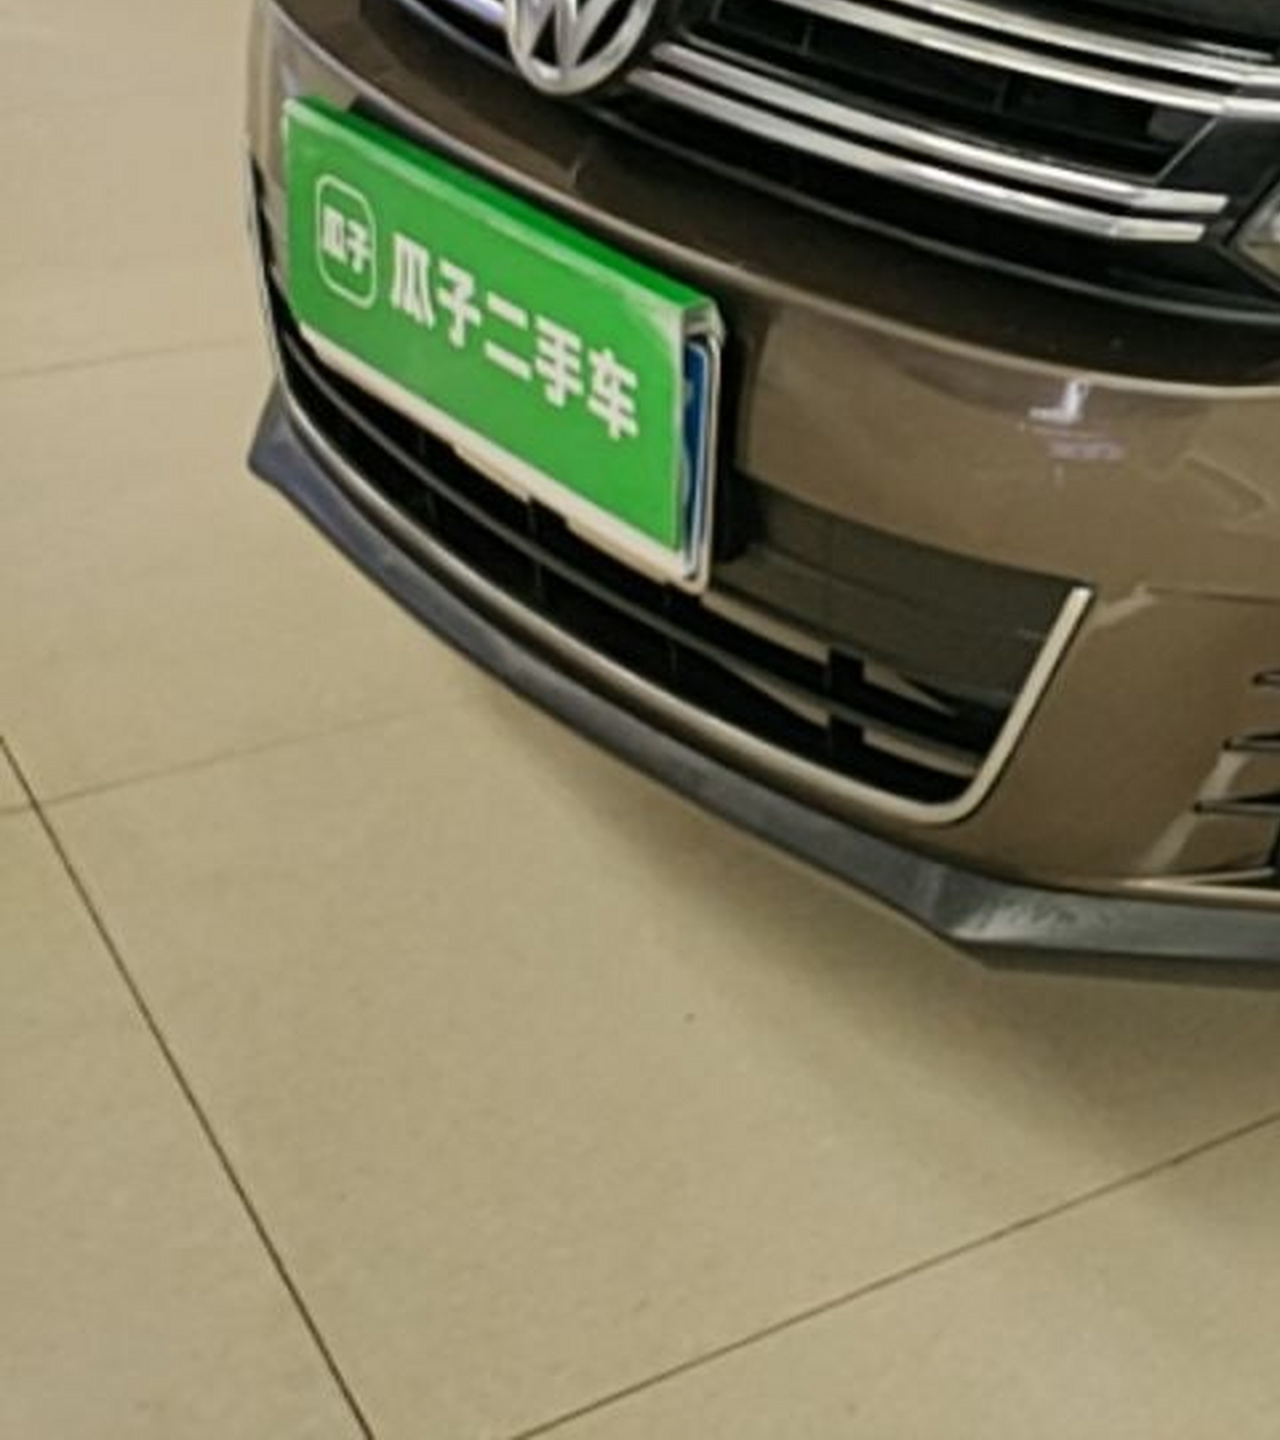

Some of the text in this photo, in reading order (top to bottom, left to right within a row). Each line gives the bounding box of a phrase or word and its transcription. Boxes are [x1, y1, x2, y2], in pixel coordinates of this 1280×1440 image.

[393, 234, 637, 440] 瓜子二手车
